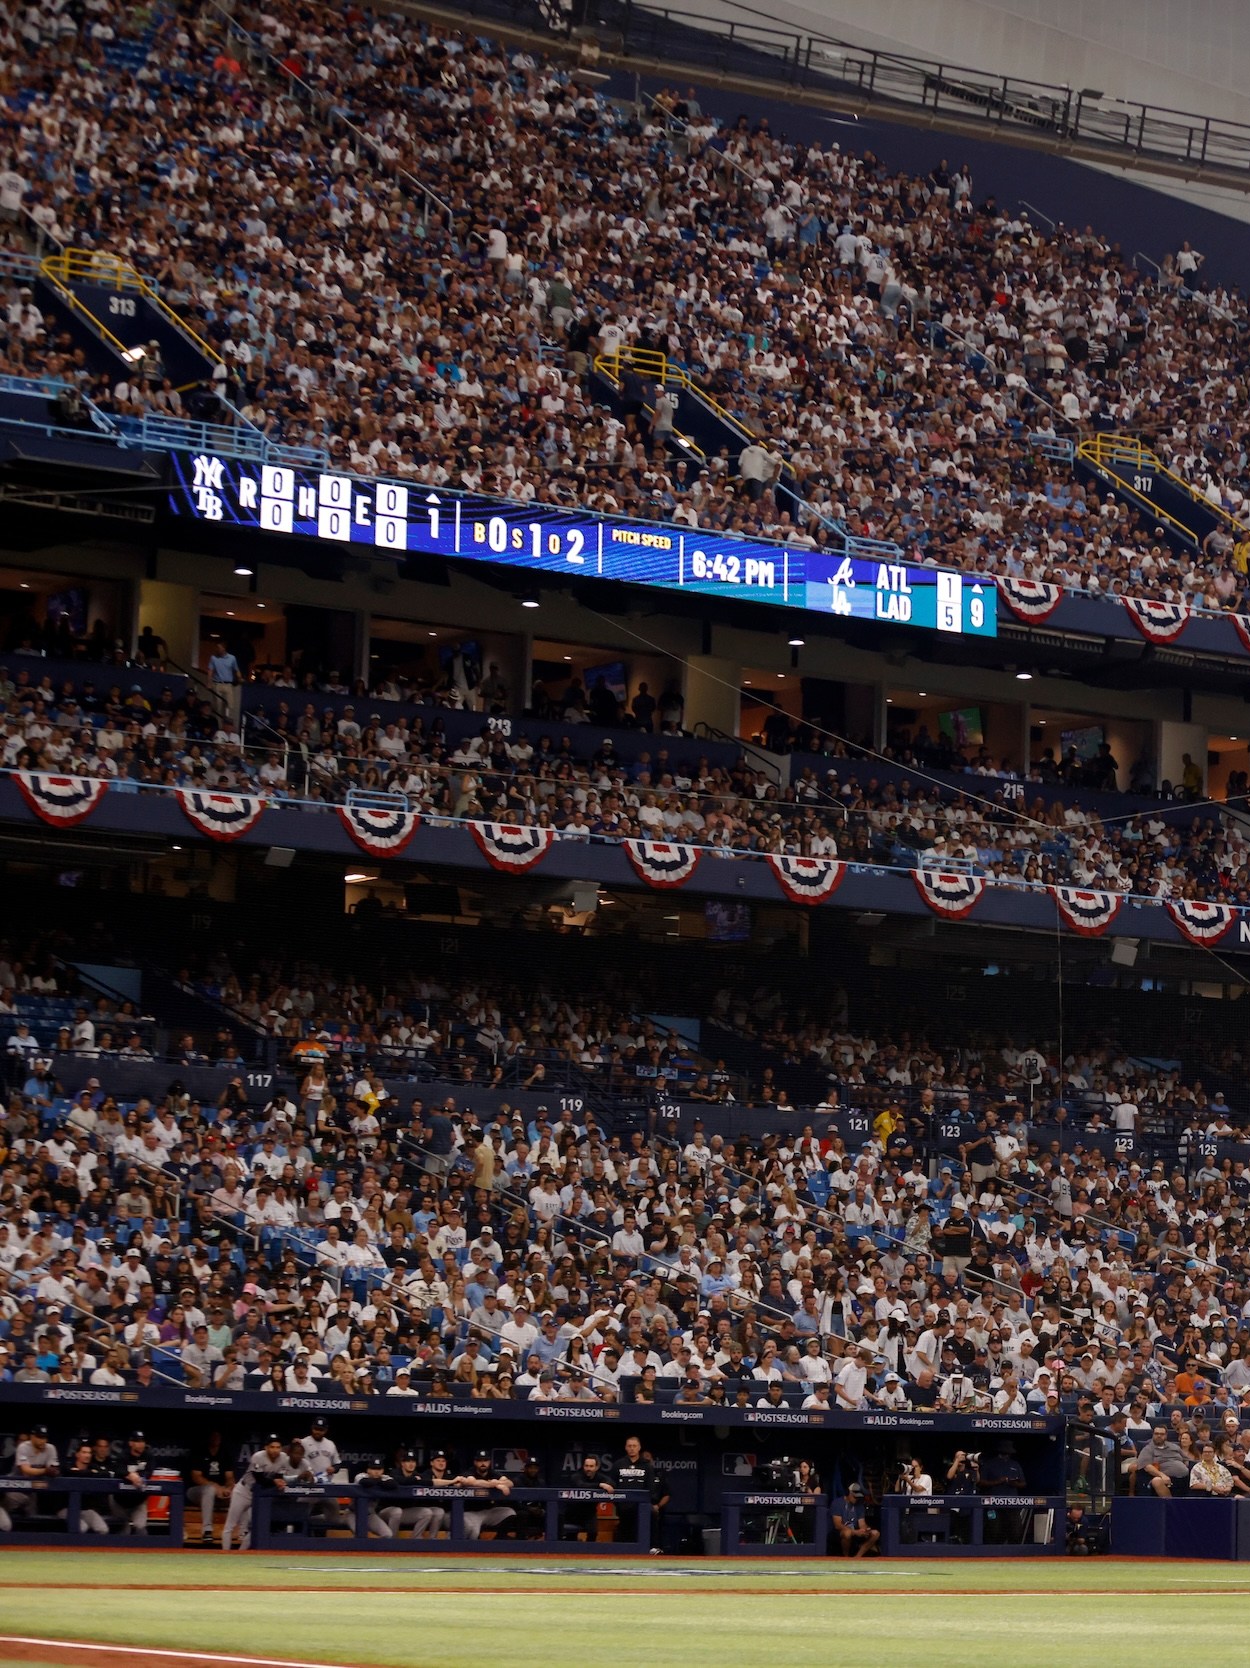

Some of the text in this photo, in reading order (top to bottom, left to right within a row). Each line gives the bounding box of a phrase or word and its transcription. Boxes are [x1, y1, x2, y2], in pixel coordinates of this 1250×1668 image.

[109, 296, 136, 318] 313
[1134, 475, 1153, 493] 317
[239, 476, 257, 509] R
[299, 486, 316, 518] H
[355, 495, 371, 526] E
[428, 507, 440, 539] 1
[474, 522, 486, 543] B
[488, 517, 508, 553] 0
[511, 527, 523, 549] S
[529, 523, 542, 557] 1
[566, 529, 585, 564] 2
[612, 529, 672, 550] PITCH SPEED
[692, 550, 775, 588] 6:42 PM
[876, 564, 954, 599] ATL 1
[876, 592, 984, 628] LAD 5 9
[487, 717, 512, 737] 213
[1003, 783, 1025, 799] 215
[247, 1073, 273, 1087] 117
[560, 1098, 583, 1112] 119
[660, 1105, 681, 1118] 121
[848, 1118, 869, 1131] 121
[940, 1125, 960, 1138] 123
[1114, 1138, 1134, 1151] 123
[1199, 1143, 1218, 1156] 125
[57, 1388, 120, 1401] POSTSEASON
[185, 1394, 233, 1405] Booking.com
[291, 1397, 350, 1410] POSTSEASON
[425, 1402, 493, 1415] ALDS Booking.com
[547, 1406, 604, 1418] POSTSEASON
[661, 1410, 703, 1421] Booking.com
[755, 1412, 809, 1424] POSTSEASON
[874, 1415, 934, 1427] ALDS Booking.com
[982, 1418, 1032, 1429] POSTSEASON
[423, 1487, 475, 1497] POSTSEASON
[568, 1490, 592, 1500] ALDS
[754, 1495, 801, 1505] POSTSEASON
[910, 1497, 944, 1506] Booking.com
[990, 1497, 1034, 1506] POSTSEASON
